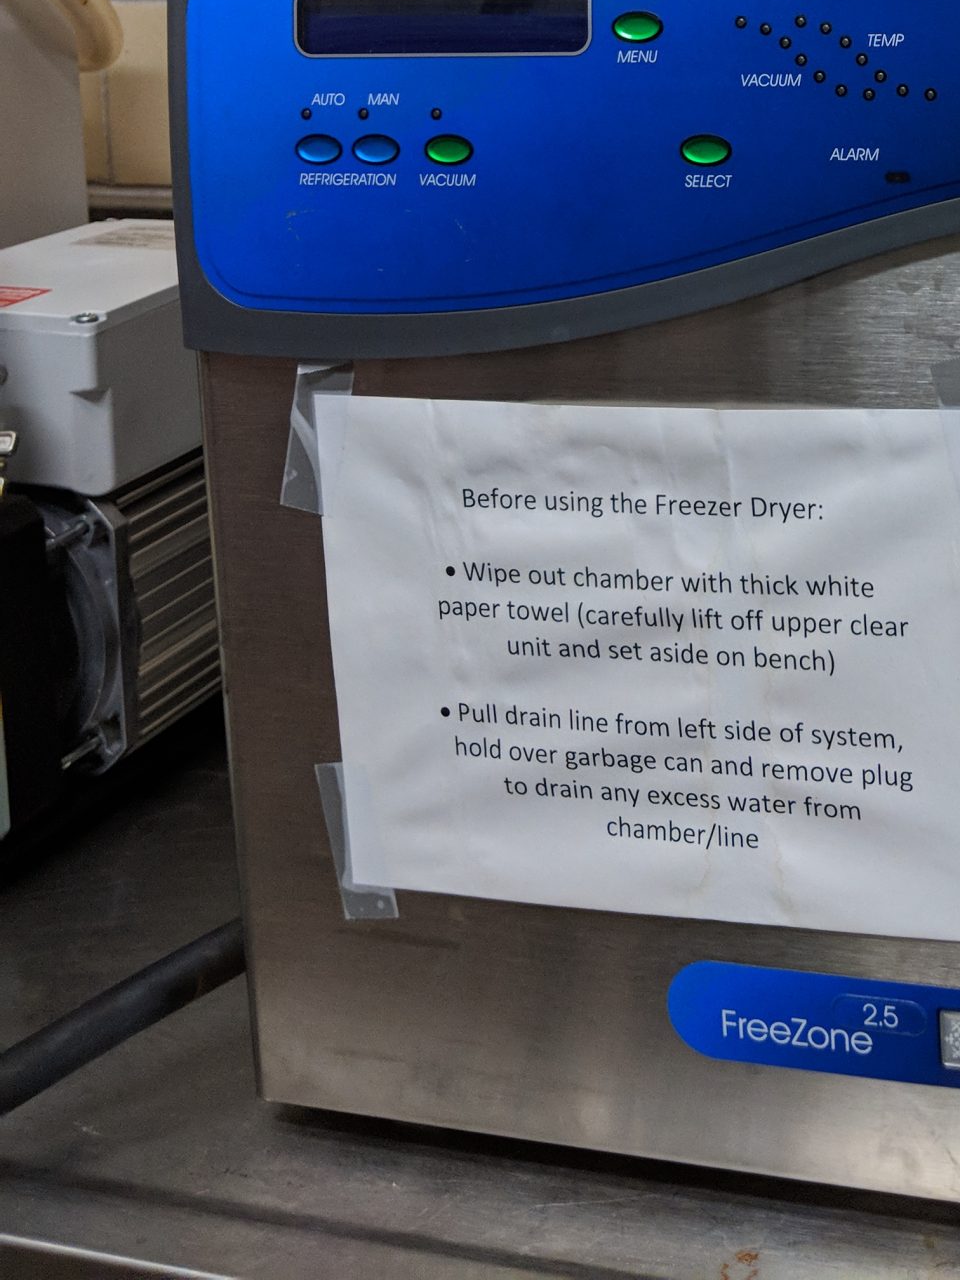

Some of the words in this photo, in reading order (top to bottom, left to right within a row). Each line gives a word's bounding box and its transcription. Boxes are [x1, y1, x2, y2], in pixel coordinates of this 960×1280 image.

[867, 32, 905, 48] TEMP
[616, 49, 659, 64] MENU
[740, 73, 802, 88] VACUUM
[310, 92, 346, 106] AUTO
[367, 92, 400, 106] MAN
[829, 147, 880, 162] ALARM
[299, 172, 397, 187] REFRIGERATION
[418, 173, 477, 187] VACUUM
[684, 174, 733, 189] SELECT
[462, 487, 537, 511] Before
[545, 490, 604, 519] using
[610, 491, 648, 515] the
[656, 493, 743, 518] Freezer
[751, 496, 825, 525] Dryer:
[462, 561, 521, 588] Wipe
[528, 567, 567, 587] out
[573, 565, 675, 592] chamber
[681, 571, 733, 594] with
[739, 572, 800, 596] thick
[805, 574, 875, 599] white
[438, 599, 501, 622] paper
[507, 600, 570, 623] towel
[577, 601, 685, 633] (carefully
[692, 607, 724, 630] lift
[731, 608, 764, 632] off
[772, 615, 843, 639] upper
[850, 613, 910, 638] clear
[508, 636, 552, 658] unit
[559, 638, 601, 660] and
[608, 642, 644, 661] set
[650, 642, 709, 665] aside
[717, 650, 746, 667] on
[754, 645, 836, 677] bench)
[458, 702, 498, 724] Pull
[504, 704, 562, 729] drain
[570, 708, 609, 734] line
[615, 712, 671, 738] from
[678, 716, 718, 740] left
[725, 719, 772, 743] side
[780, 721, 805, 744] of
[811, 727, 903, 754] system,
[455, 735, 502, 760] hold
[509, 745, 559, 765] over
[565, 747, 657, 774] garbage
[664, 755, 703, 774] can
[711, 755, 754, 777] and
[762, 762, 853, 784] remove
[862, 763, 914, 793] plug
[503, 776, 528, 796] to
[535, 776, 594, 800] drain
[601, 785, 641, 808] any
[648, 789, 721, 810] excess
[727, 794, 797, 815] water
[803, 795, 864, 821] from
[607, 815, 760, 851] chamber/line
[862, 1002, 899, 1029] 2.5
[721, 1008, 874, 1055] FreeZone
